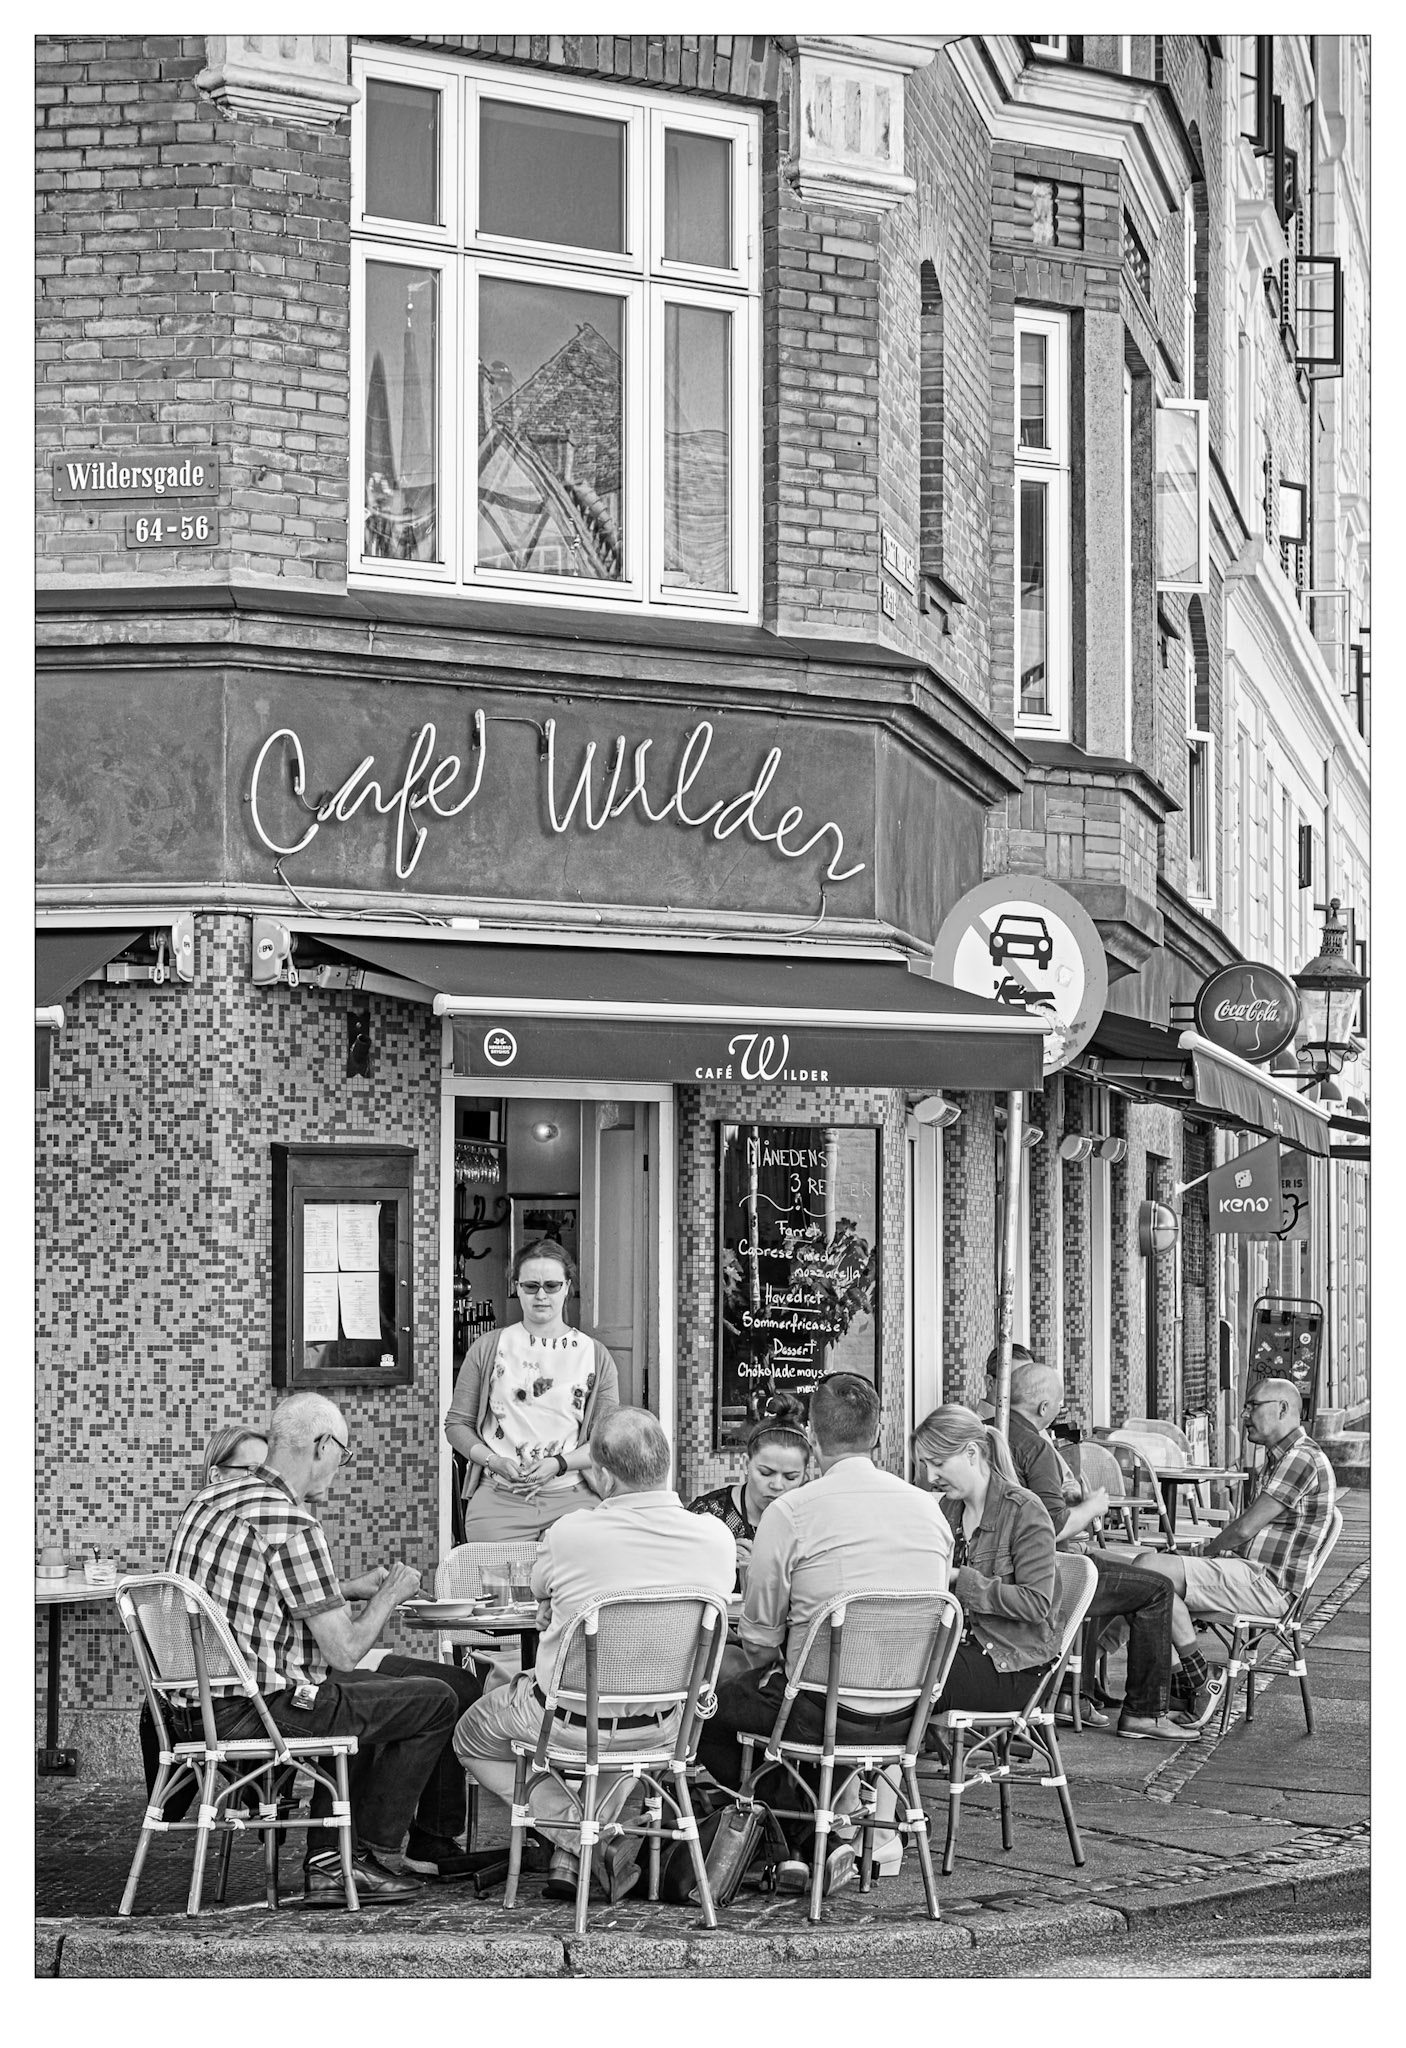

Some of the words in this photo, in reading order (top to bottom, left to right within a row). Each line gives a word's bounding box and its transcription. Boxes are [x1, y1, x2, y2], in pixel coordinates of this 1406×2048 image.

[66, 460, 204, 494] Wildersgade
[136, 516, 209, 543] 64-56
[251, 709, 485, 878] Café
[544, 718, 866, 881] Wilder
[1214, 999, 1280, 1022] Coca-Cola
[695, 1064, 733, 1080] CAFÉ
[746, 1136, 829, 1168] MÅNEDENS
[789, 1172, 802, 1193] 3
